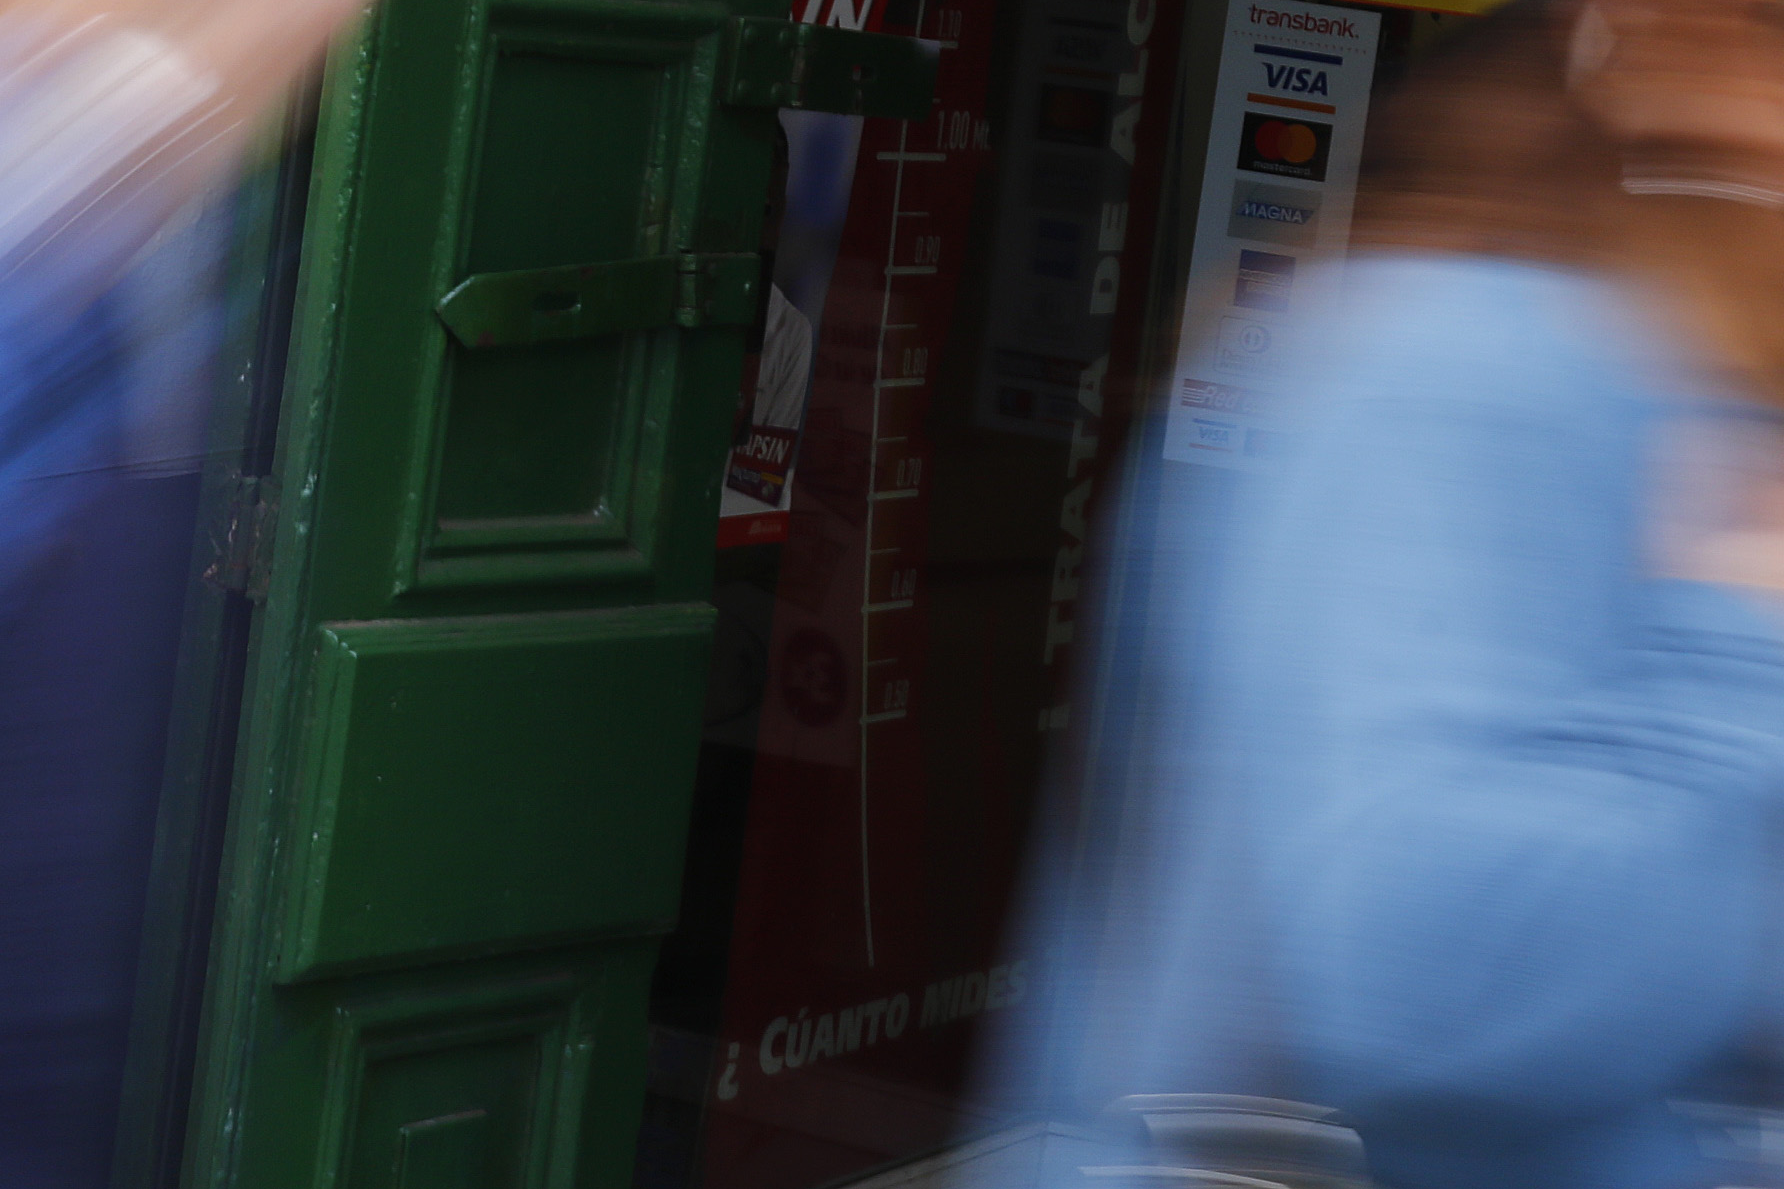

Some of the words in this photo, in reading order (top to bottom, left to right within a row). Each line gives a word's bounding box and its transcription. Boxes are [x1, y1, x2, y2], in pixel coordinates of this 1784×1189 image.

[1262, 62, 1329, 97] VISA
[1240, 200, 1306, 225] MAGNA
[1043, 352, 1112, 665] TRATA
[1089, 202, 1129, 315] DE
[919, 959, 1033, 1031] MIDES
